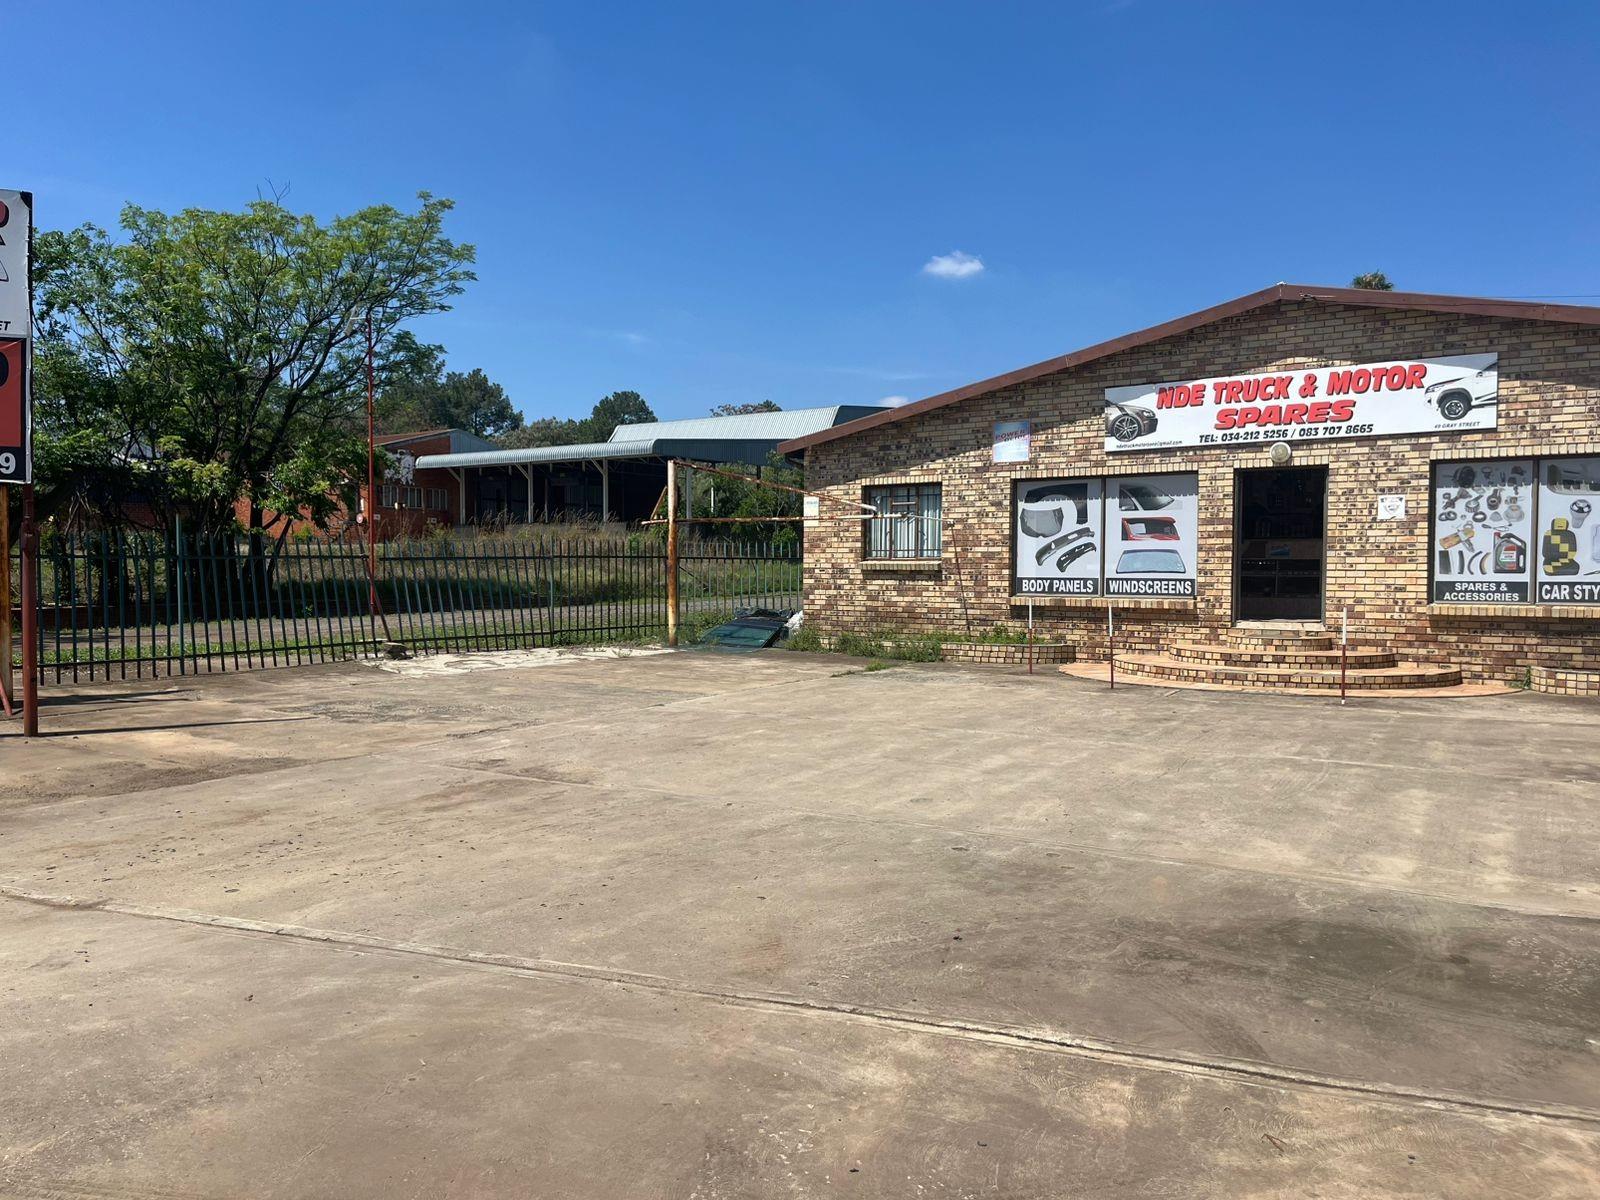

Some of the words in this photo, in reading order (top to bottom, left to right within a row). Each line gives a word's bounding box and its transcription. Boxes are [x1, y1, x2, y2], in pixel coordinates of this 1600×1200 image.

[1156, 383, 1206, 409] NDE
[1213, 375, 1293, 404] TRUCK
[1299, 373, 1318, 398] &
[1326, 364, 1427, 396] MOTOR
[1214, 399, 1356, 430] SPARES
[1199, 434, 1218, 444] TEL:
[1263, 429, 1288, 440] 5256
[1299, 427, 1319, 437] 083
[1323, 425, 1342, 436] 707
[1345, 424, 1374, 435] 8665
[1022, 579, 1050, 593] BODY
[1053, 579, 1094, 593] PANELS
[1109, 579, 1192, 594] WINDSCREENS
[1455, 583, 1496, 591] SPARES
[1500, 583, 1508, 591] &
[1541, 584, 1570, 600] CAR
[1573, 584, 1600, 600] STY
[1443, 592, 1519, 601] ACCESSORIES
